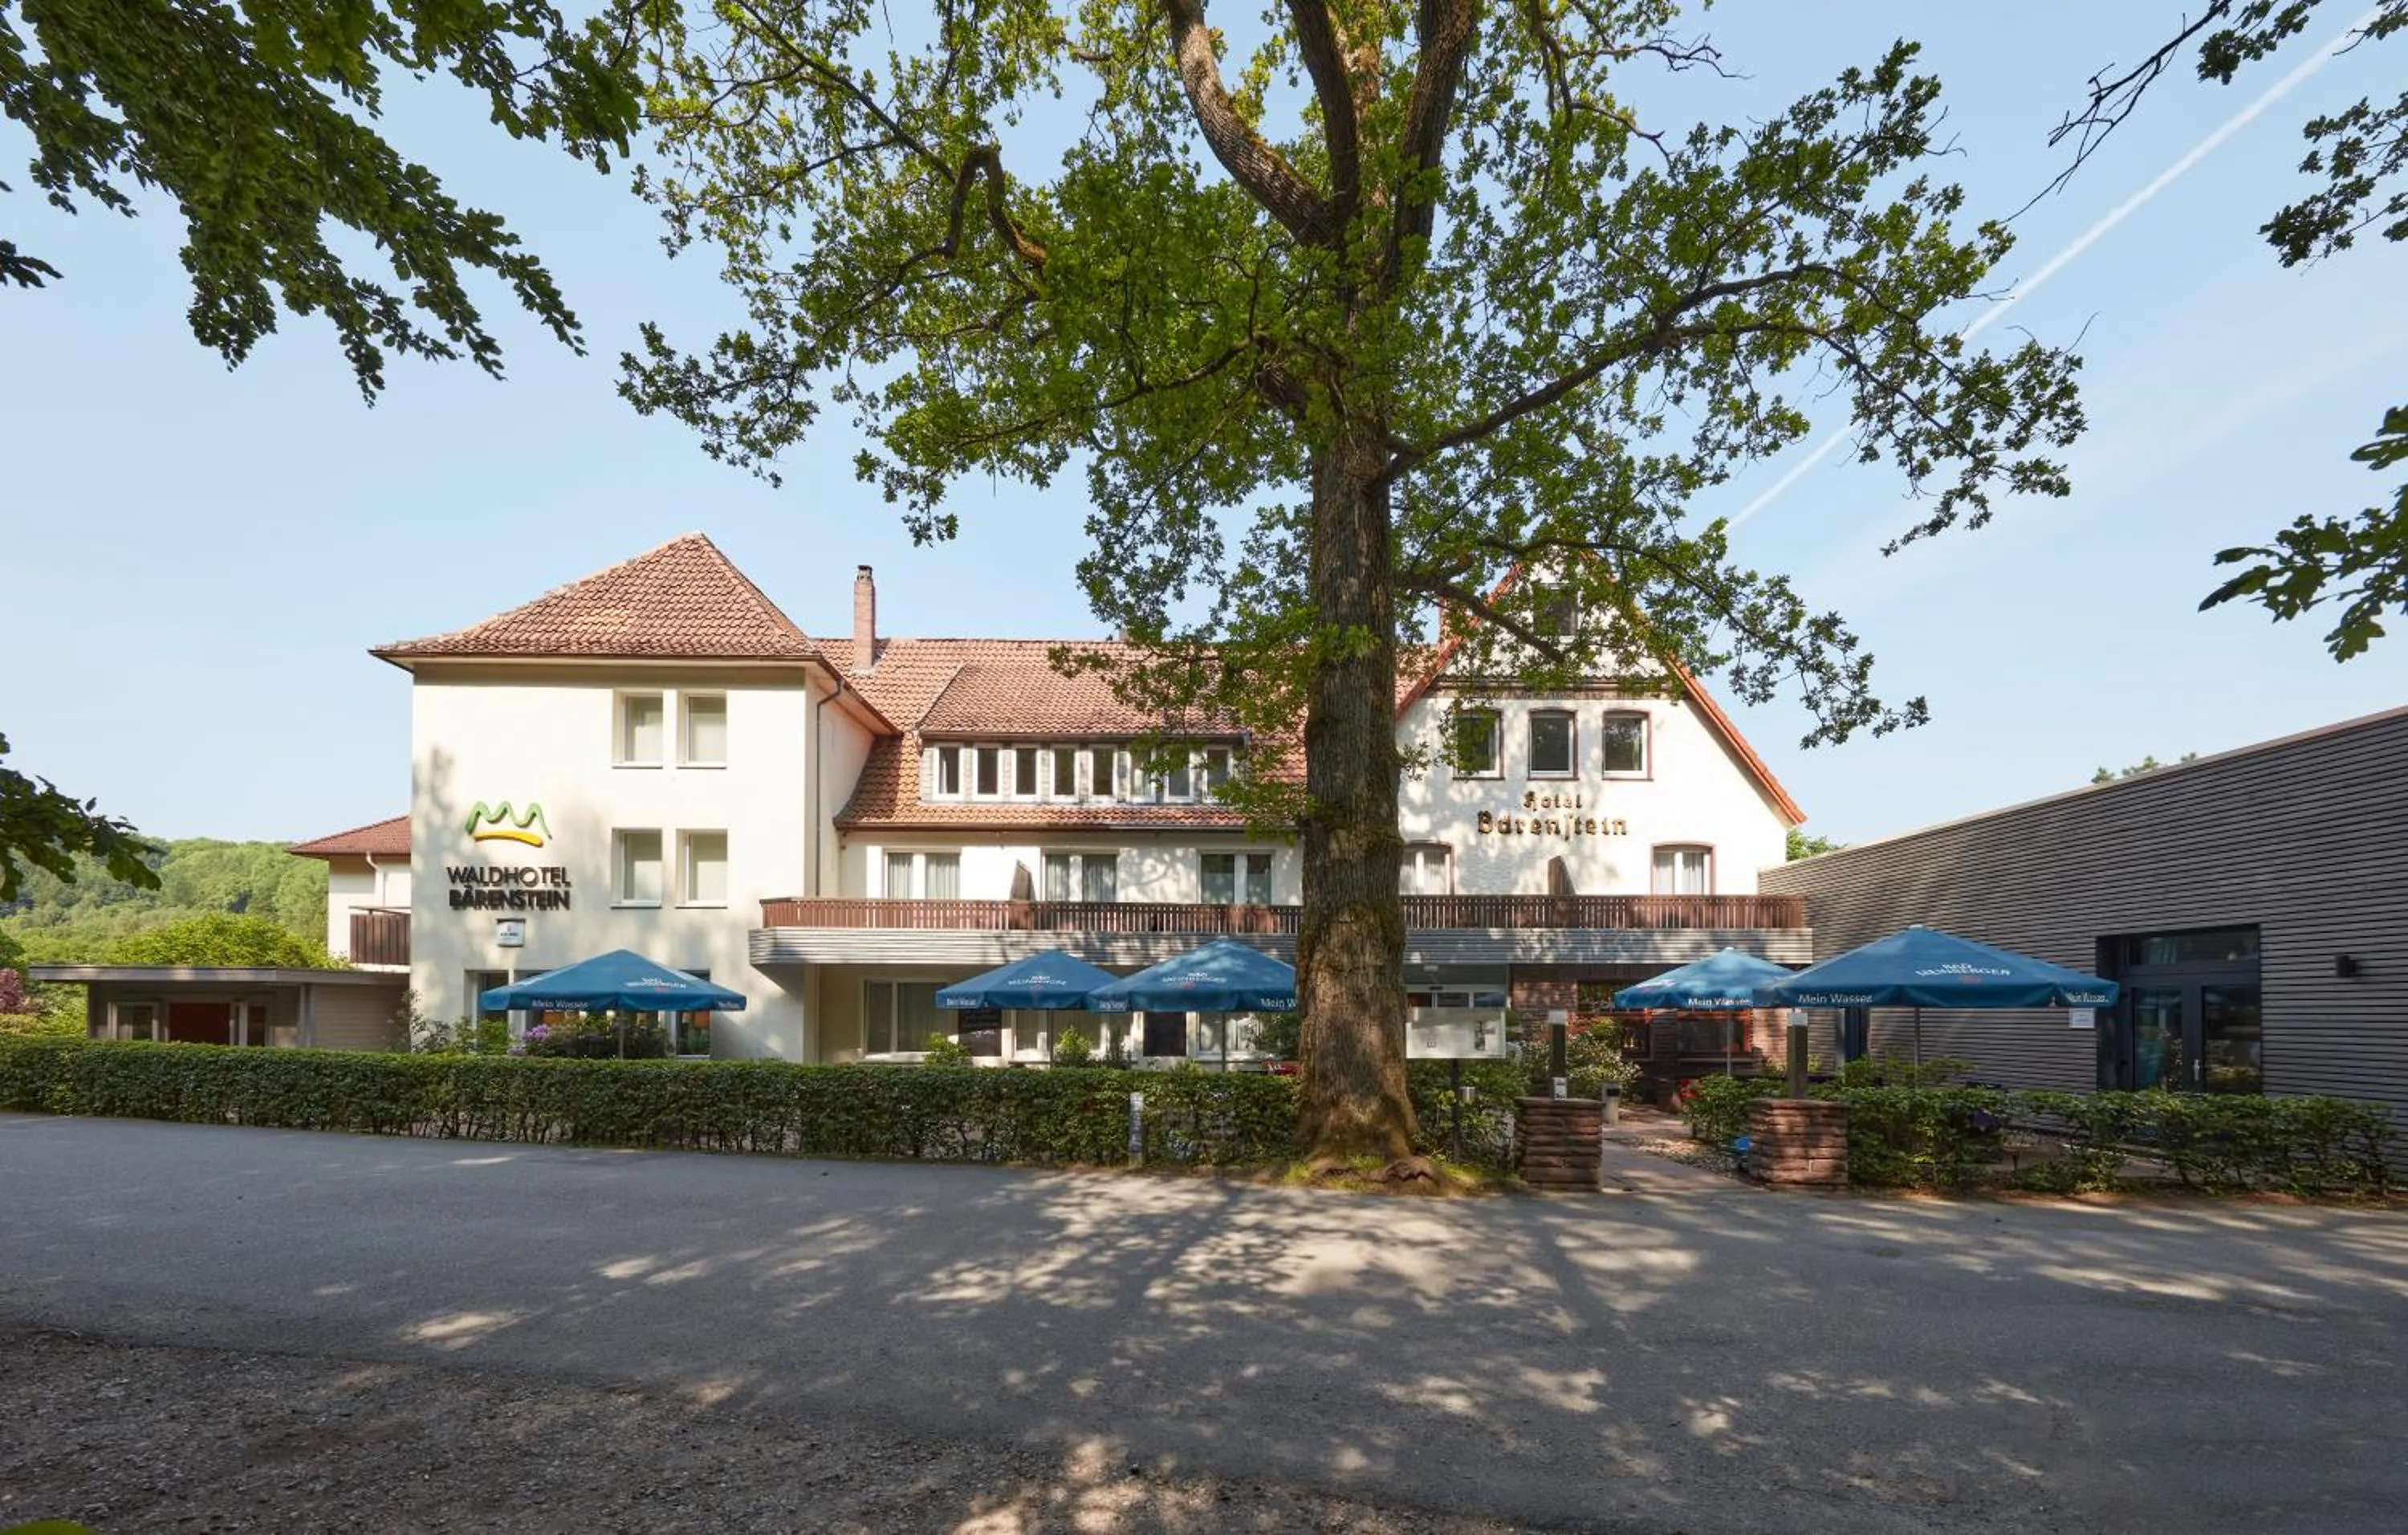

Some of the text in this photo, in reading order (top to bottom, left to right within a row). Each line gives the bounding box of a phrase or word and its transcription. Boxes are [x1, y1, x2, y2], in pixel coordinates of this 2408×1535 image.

[446, 866, 571, 888] WALDHOTEL
[449, 885, 571, 910] BÄRENSTEIN
[1797, 993, 1827, 1004] Mein
